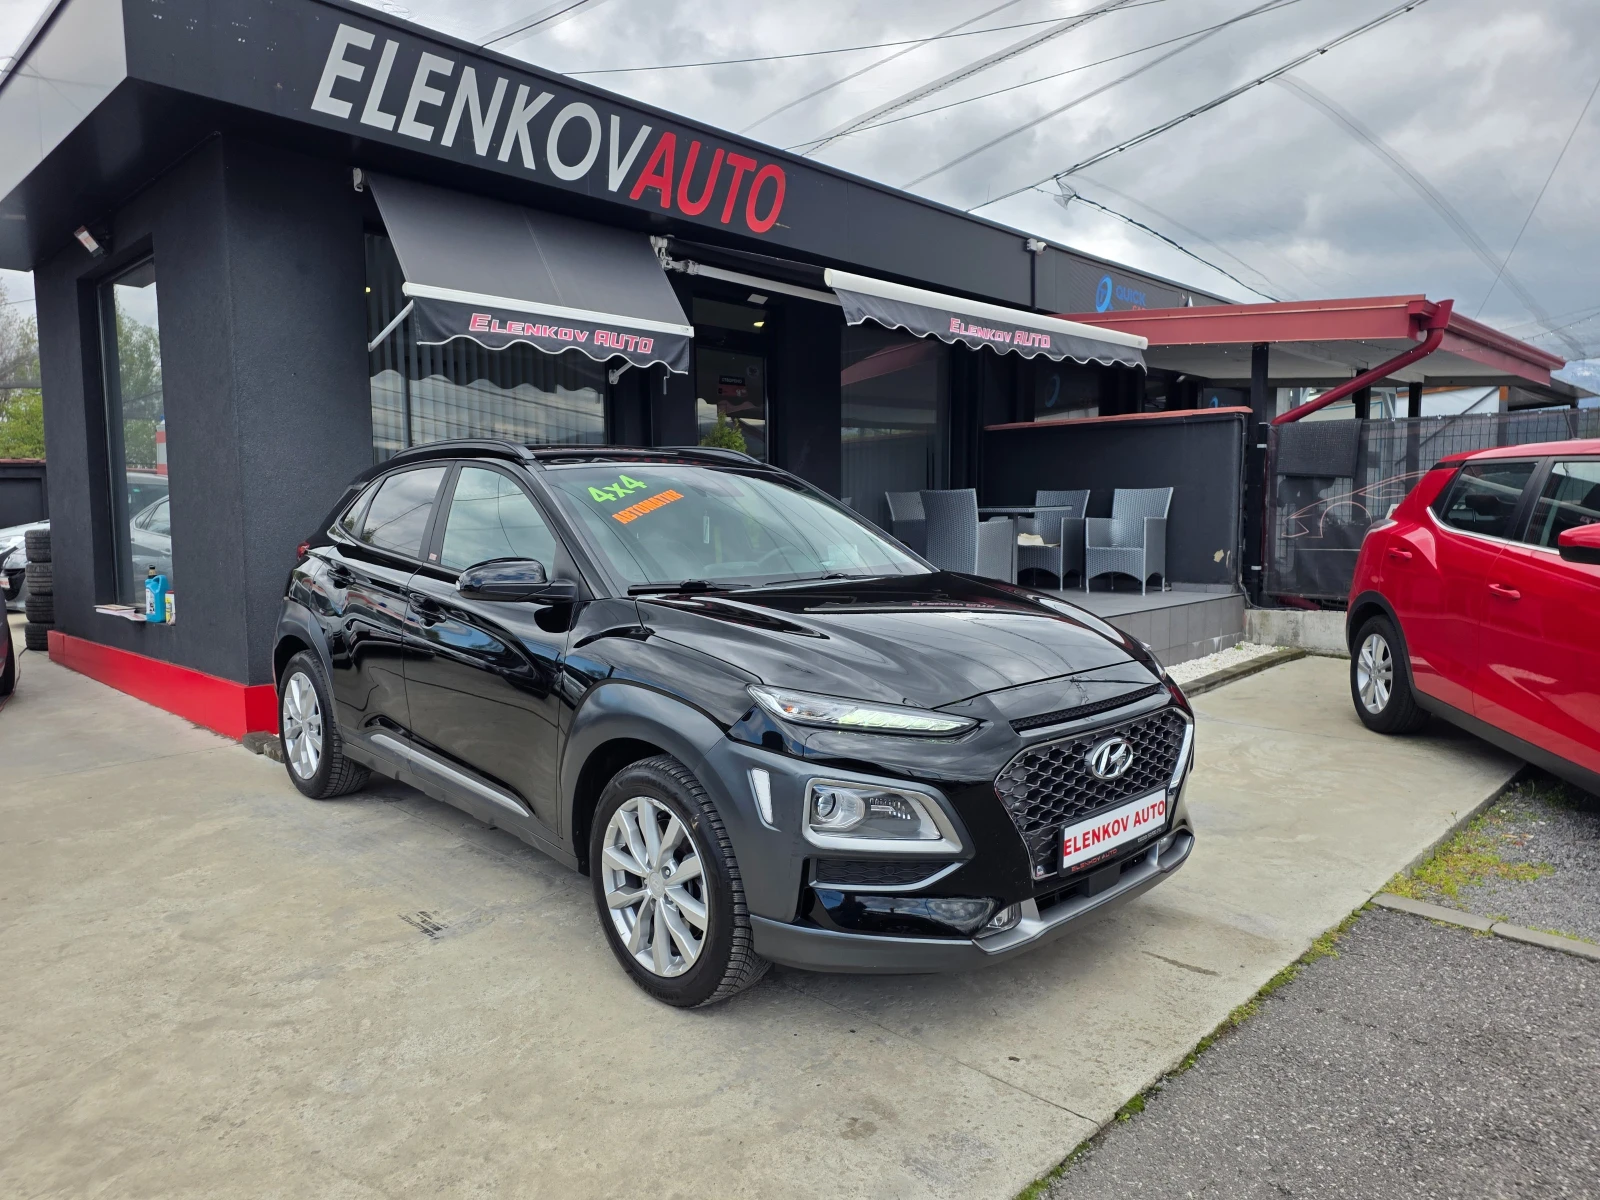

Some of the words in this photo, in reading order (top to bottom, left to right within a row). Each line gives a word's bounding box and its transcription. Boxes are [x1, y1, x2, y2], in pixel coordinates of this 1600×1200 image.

[1116, 285, 1146, 306] QUICK
[468, 312, 589, 343] ELENKOV
[594, 329, 655, 354] AUTO
[949, 317, 1012, 343] ELENKOV
[1013, 330, 1051, 348] AUTO
[588, 474, 647, 502] 4x4
[1063, 815, 1129, 857] ELENKOV
[1133, 800, 1165, 828] AUTO
[1101, 848, 1118, 860] AUTO
